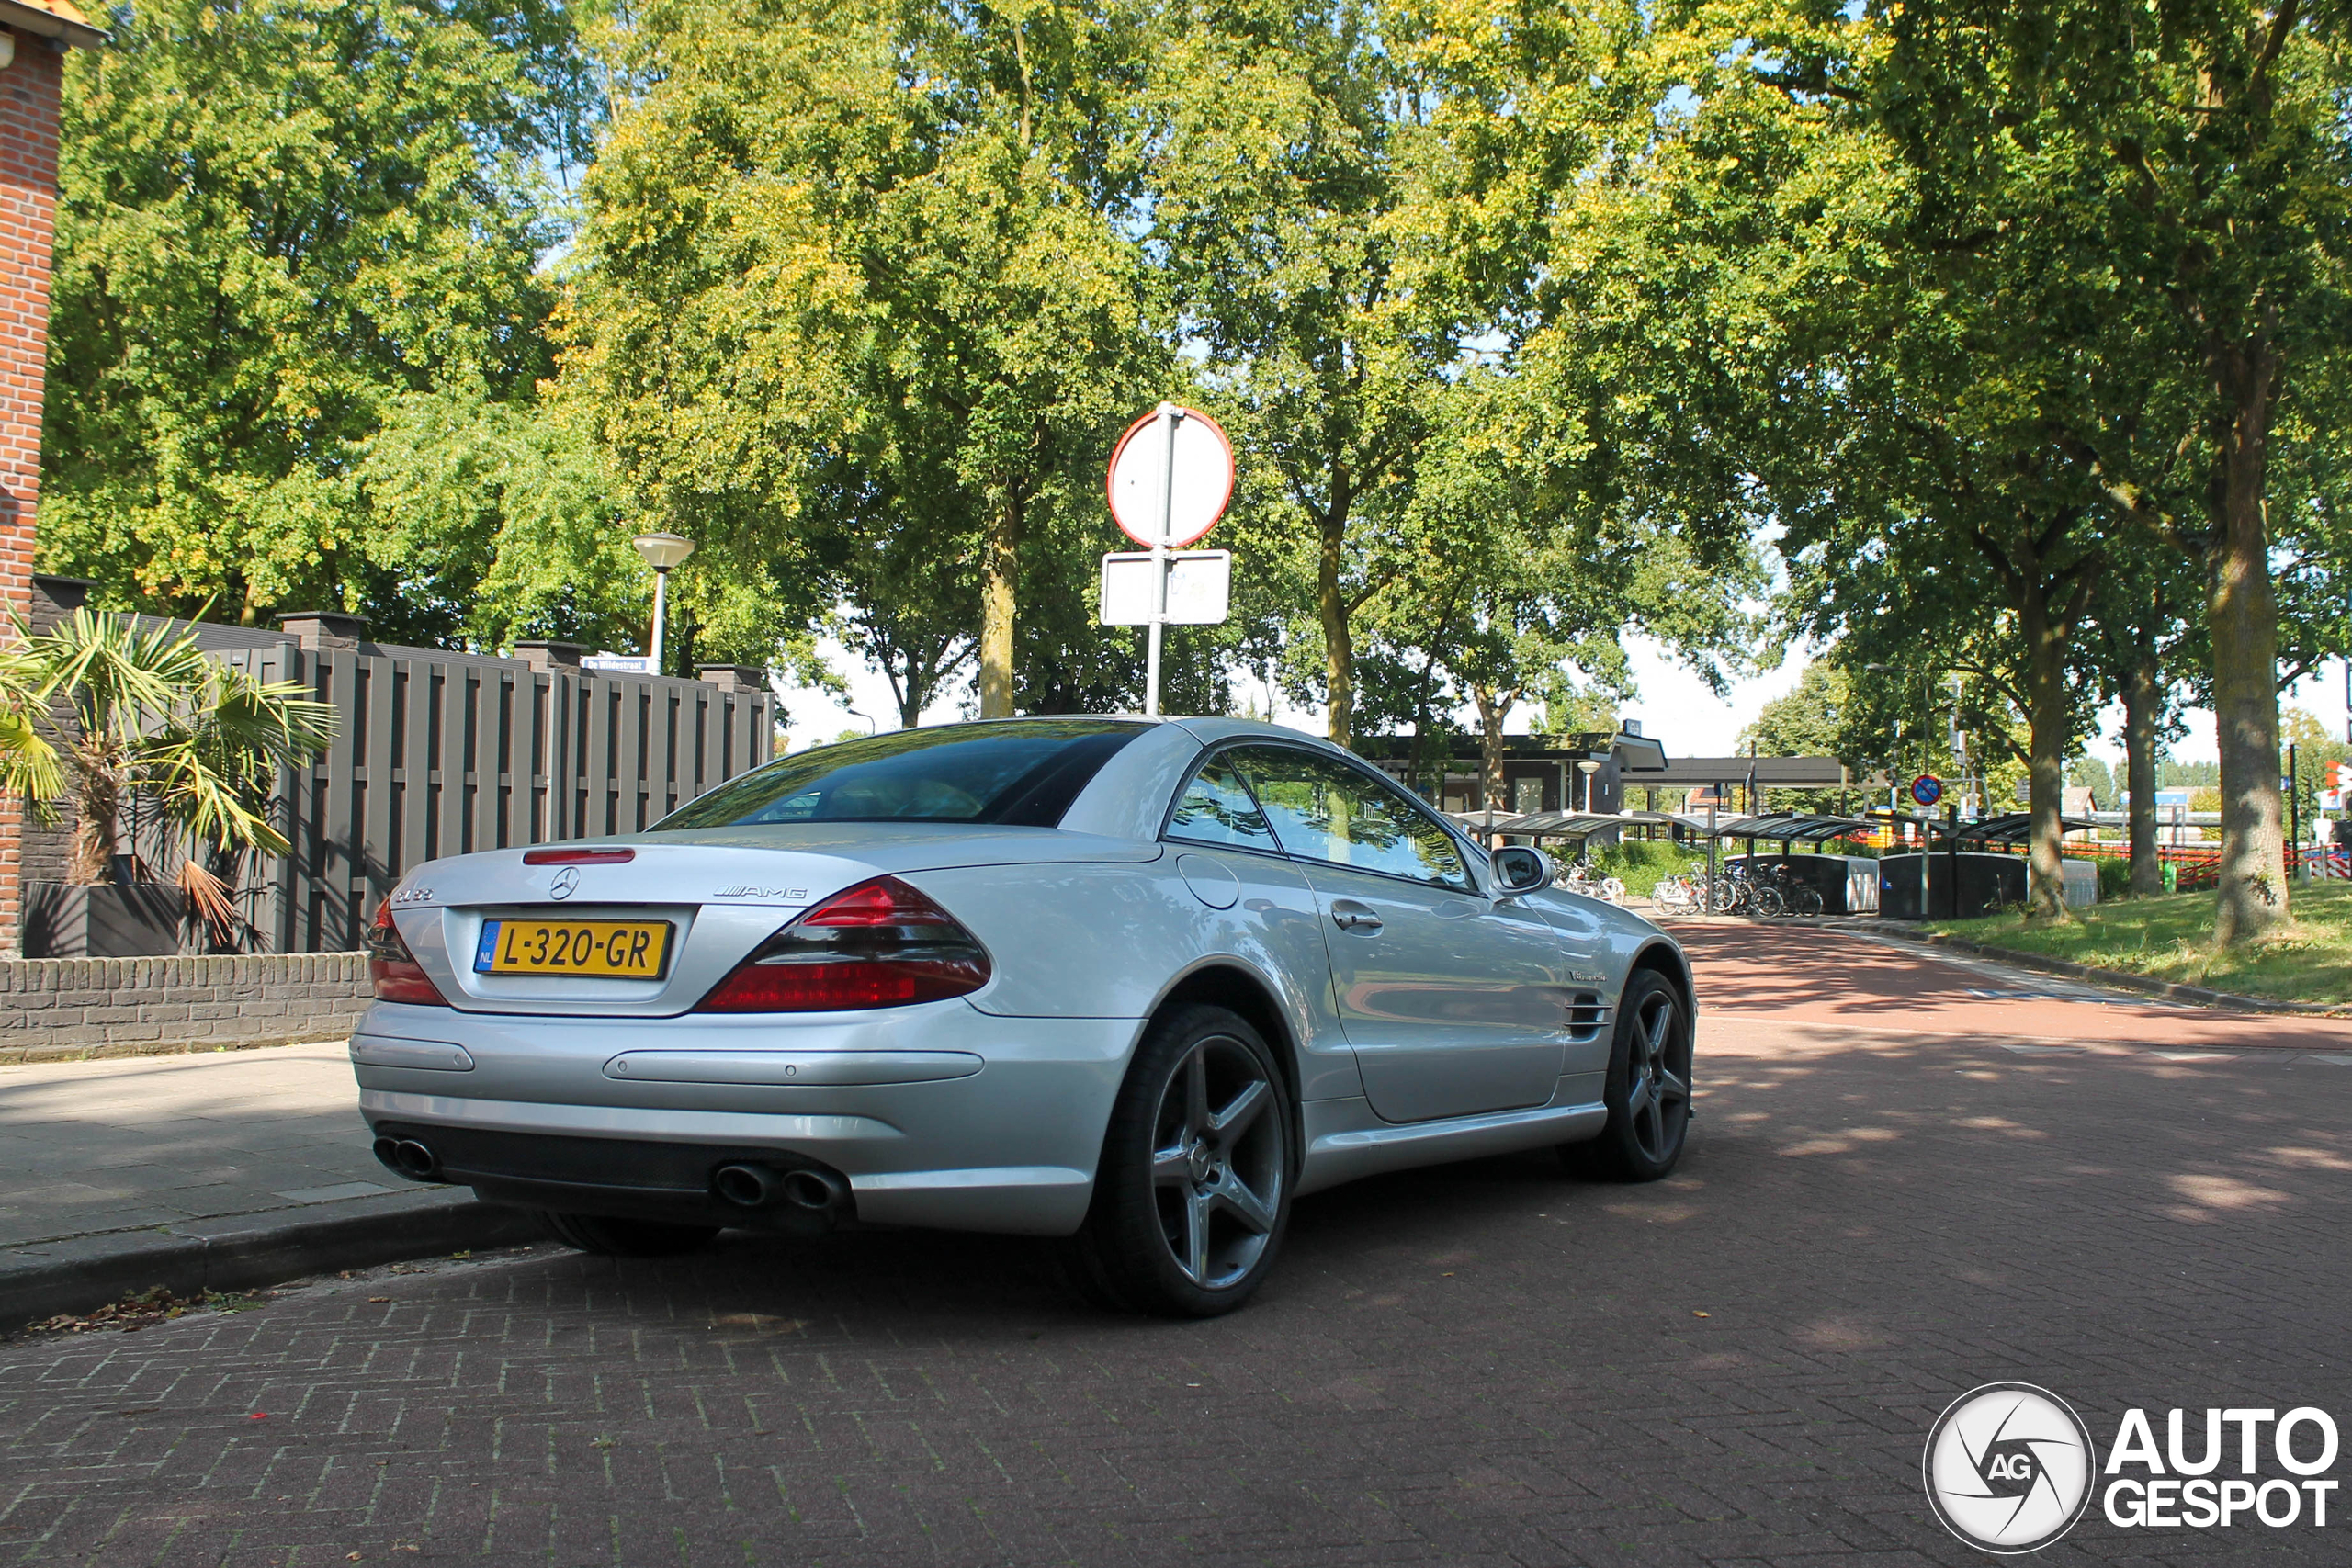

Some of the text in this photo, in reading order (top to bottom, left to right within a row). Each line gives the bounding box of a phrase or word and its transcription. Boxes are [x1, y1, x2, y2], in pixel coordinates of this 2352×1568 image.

[588, 660, 642, 670] De Wildestraat
[741, 886, 808, 899] AMG
[503, 928, 650, 968] L-320-GR
[480, 952, 492, 964] NL
